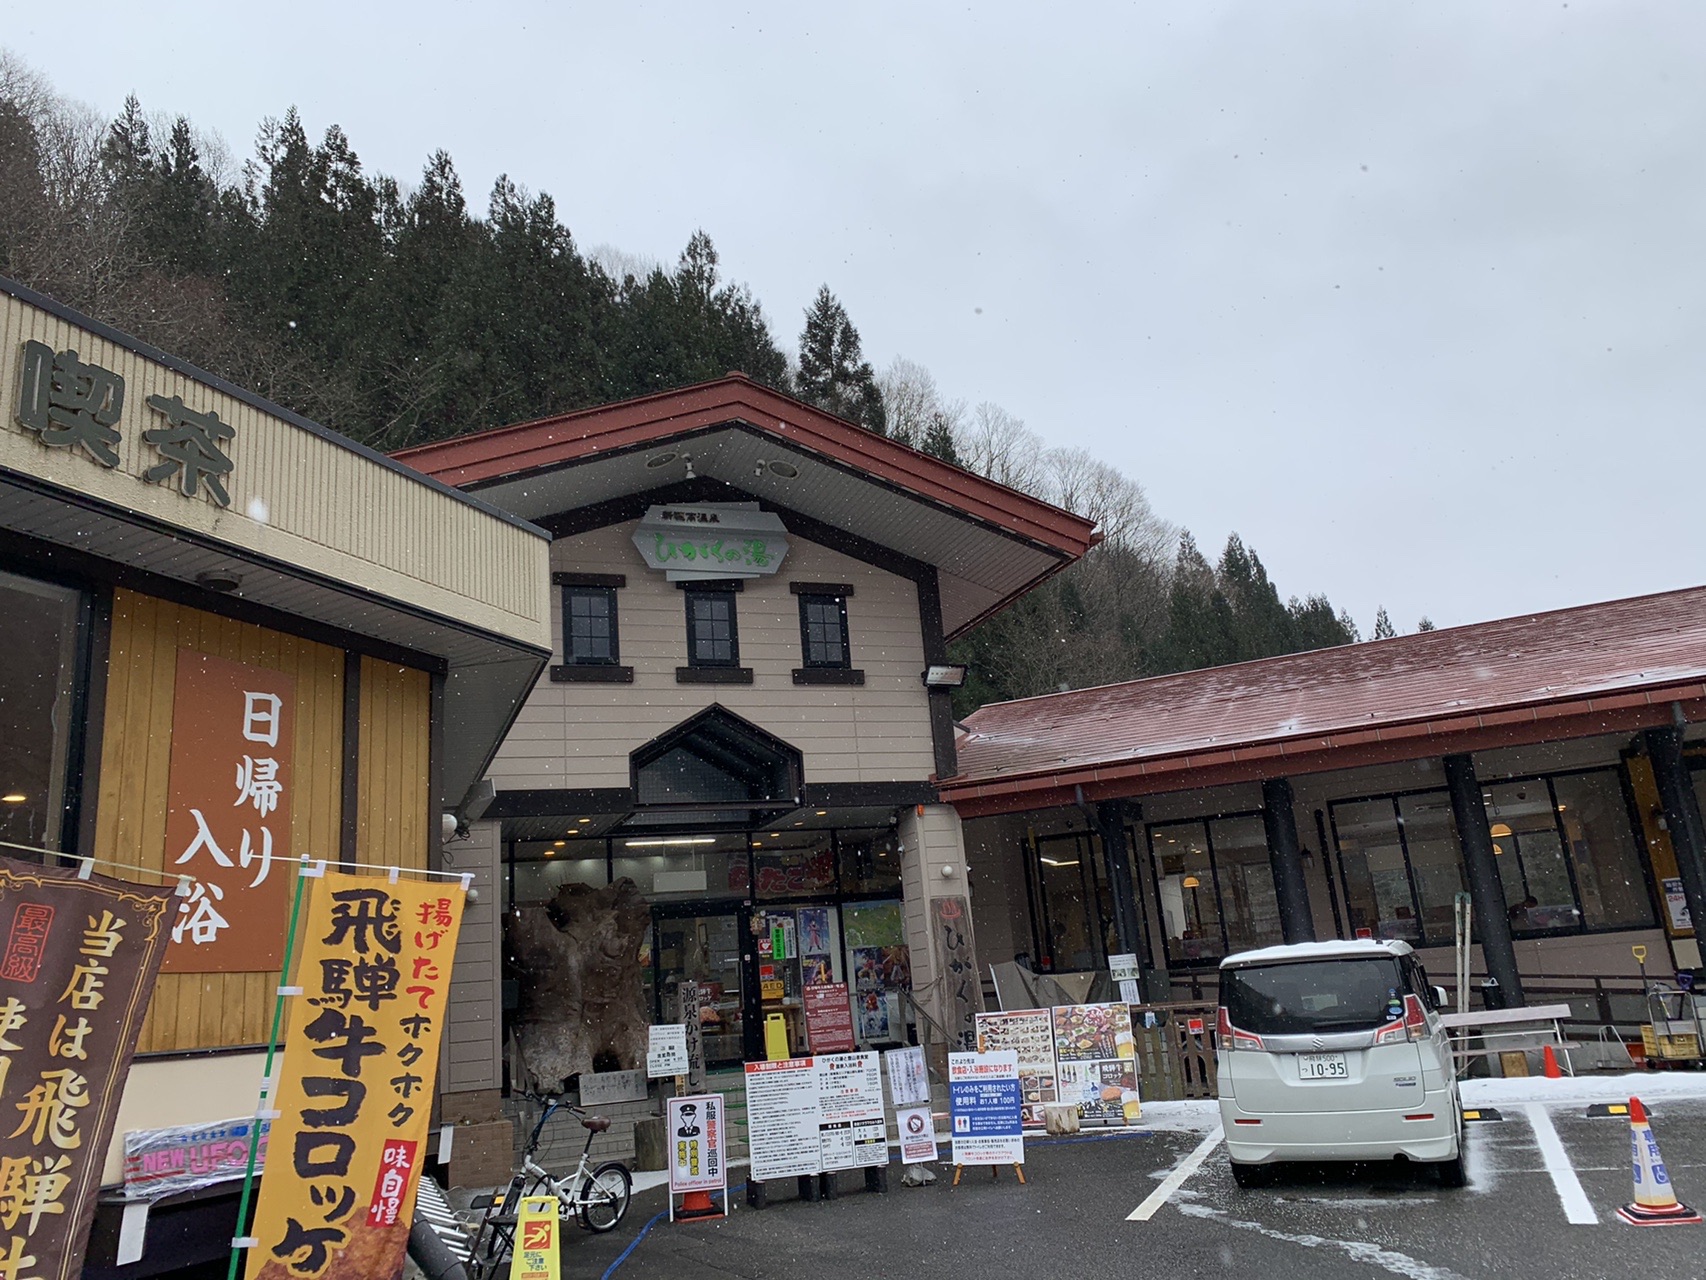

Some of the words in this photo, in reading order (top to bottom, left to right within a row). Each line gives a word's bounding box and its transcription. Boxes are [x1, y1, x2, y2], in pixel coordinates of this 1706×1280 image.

[15, 339, 235, 507] 喫茶
[234, 691, 282, 888] 日帰り
[172, 809, 234, 945] 入浴
[4, 906, 49, 981] 最高級
[405, 898, 453, 1010] 揚げたて
[272, 888, 403, 1274] 飛騨牛コロッケ
[387, 1012, 432, 1128] ホクホク
[1310, 1062, 1345, 1076] 10-95
[142, 1148, 185, 1173] NEW
[190, 1140, 249, 1174] UFO
[370, 1148, 411, 1225] 味自慢
[1642, 1129, 1661, 1157] 専用
